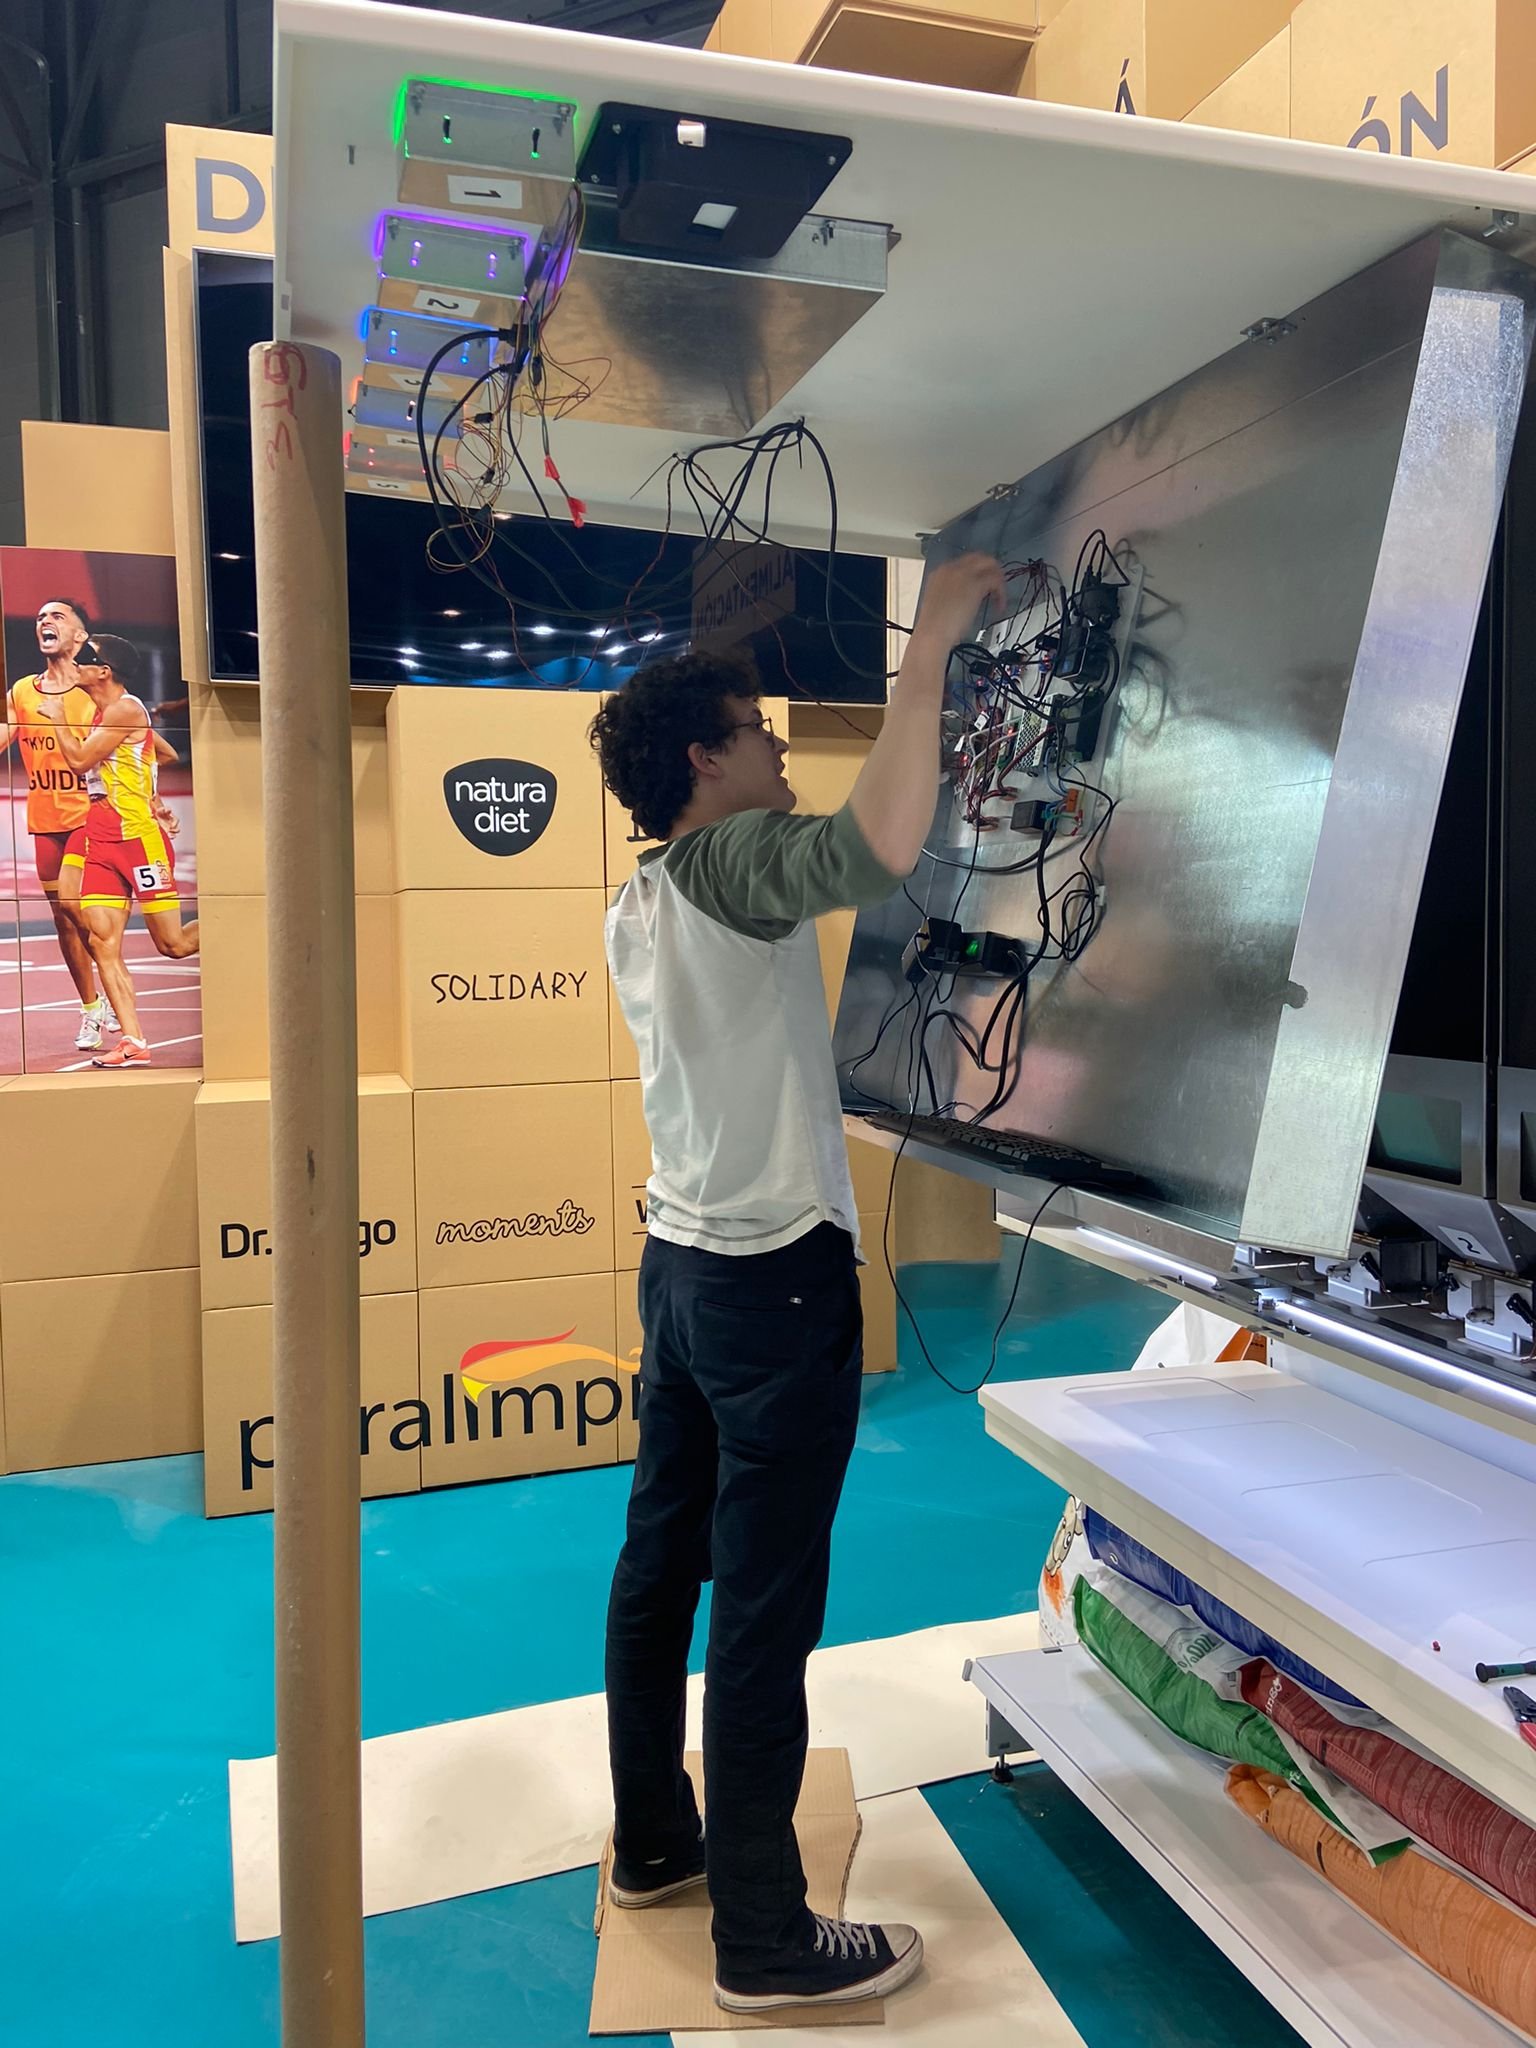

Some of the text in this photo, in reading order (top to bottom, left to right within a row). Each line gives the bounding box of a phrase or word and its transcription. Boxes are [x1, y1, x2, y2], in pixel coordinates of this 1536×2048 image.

[464, 190, 502, 199] 1
[427, 298, 459, 310] 2
[455, 776, 547, 803] natura
[474, 805, 531, 833] diet
[139, 867, 156, 888] 5
[431, 971, 588, 1004] SOLIDARY
[435, 1199, 596, 1245] moments
[220, 1223, 273, 1259] Dr.
